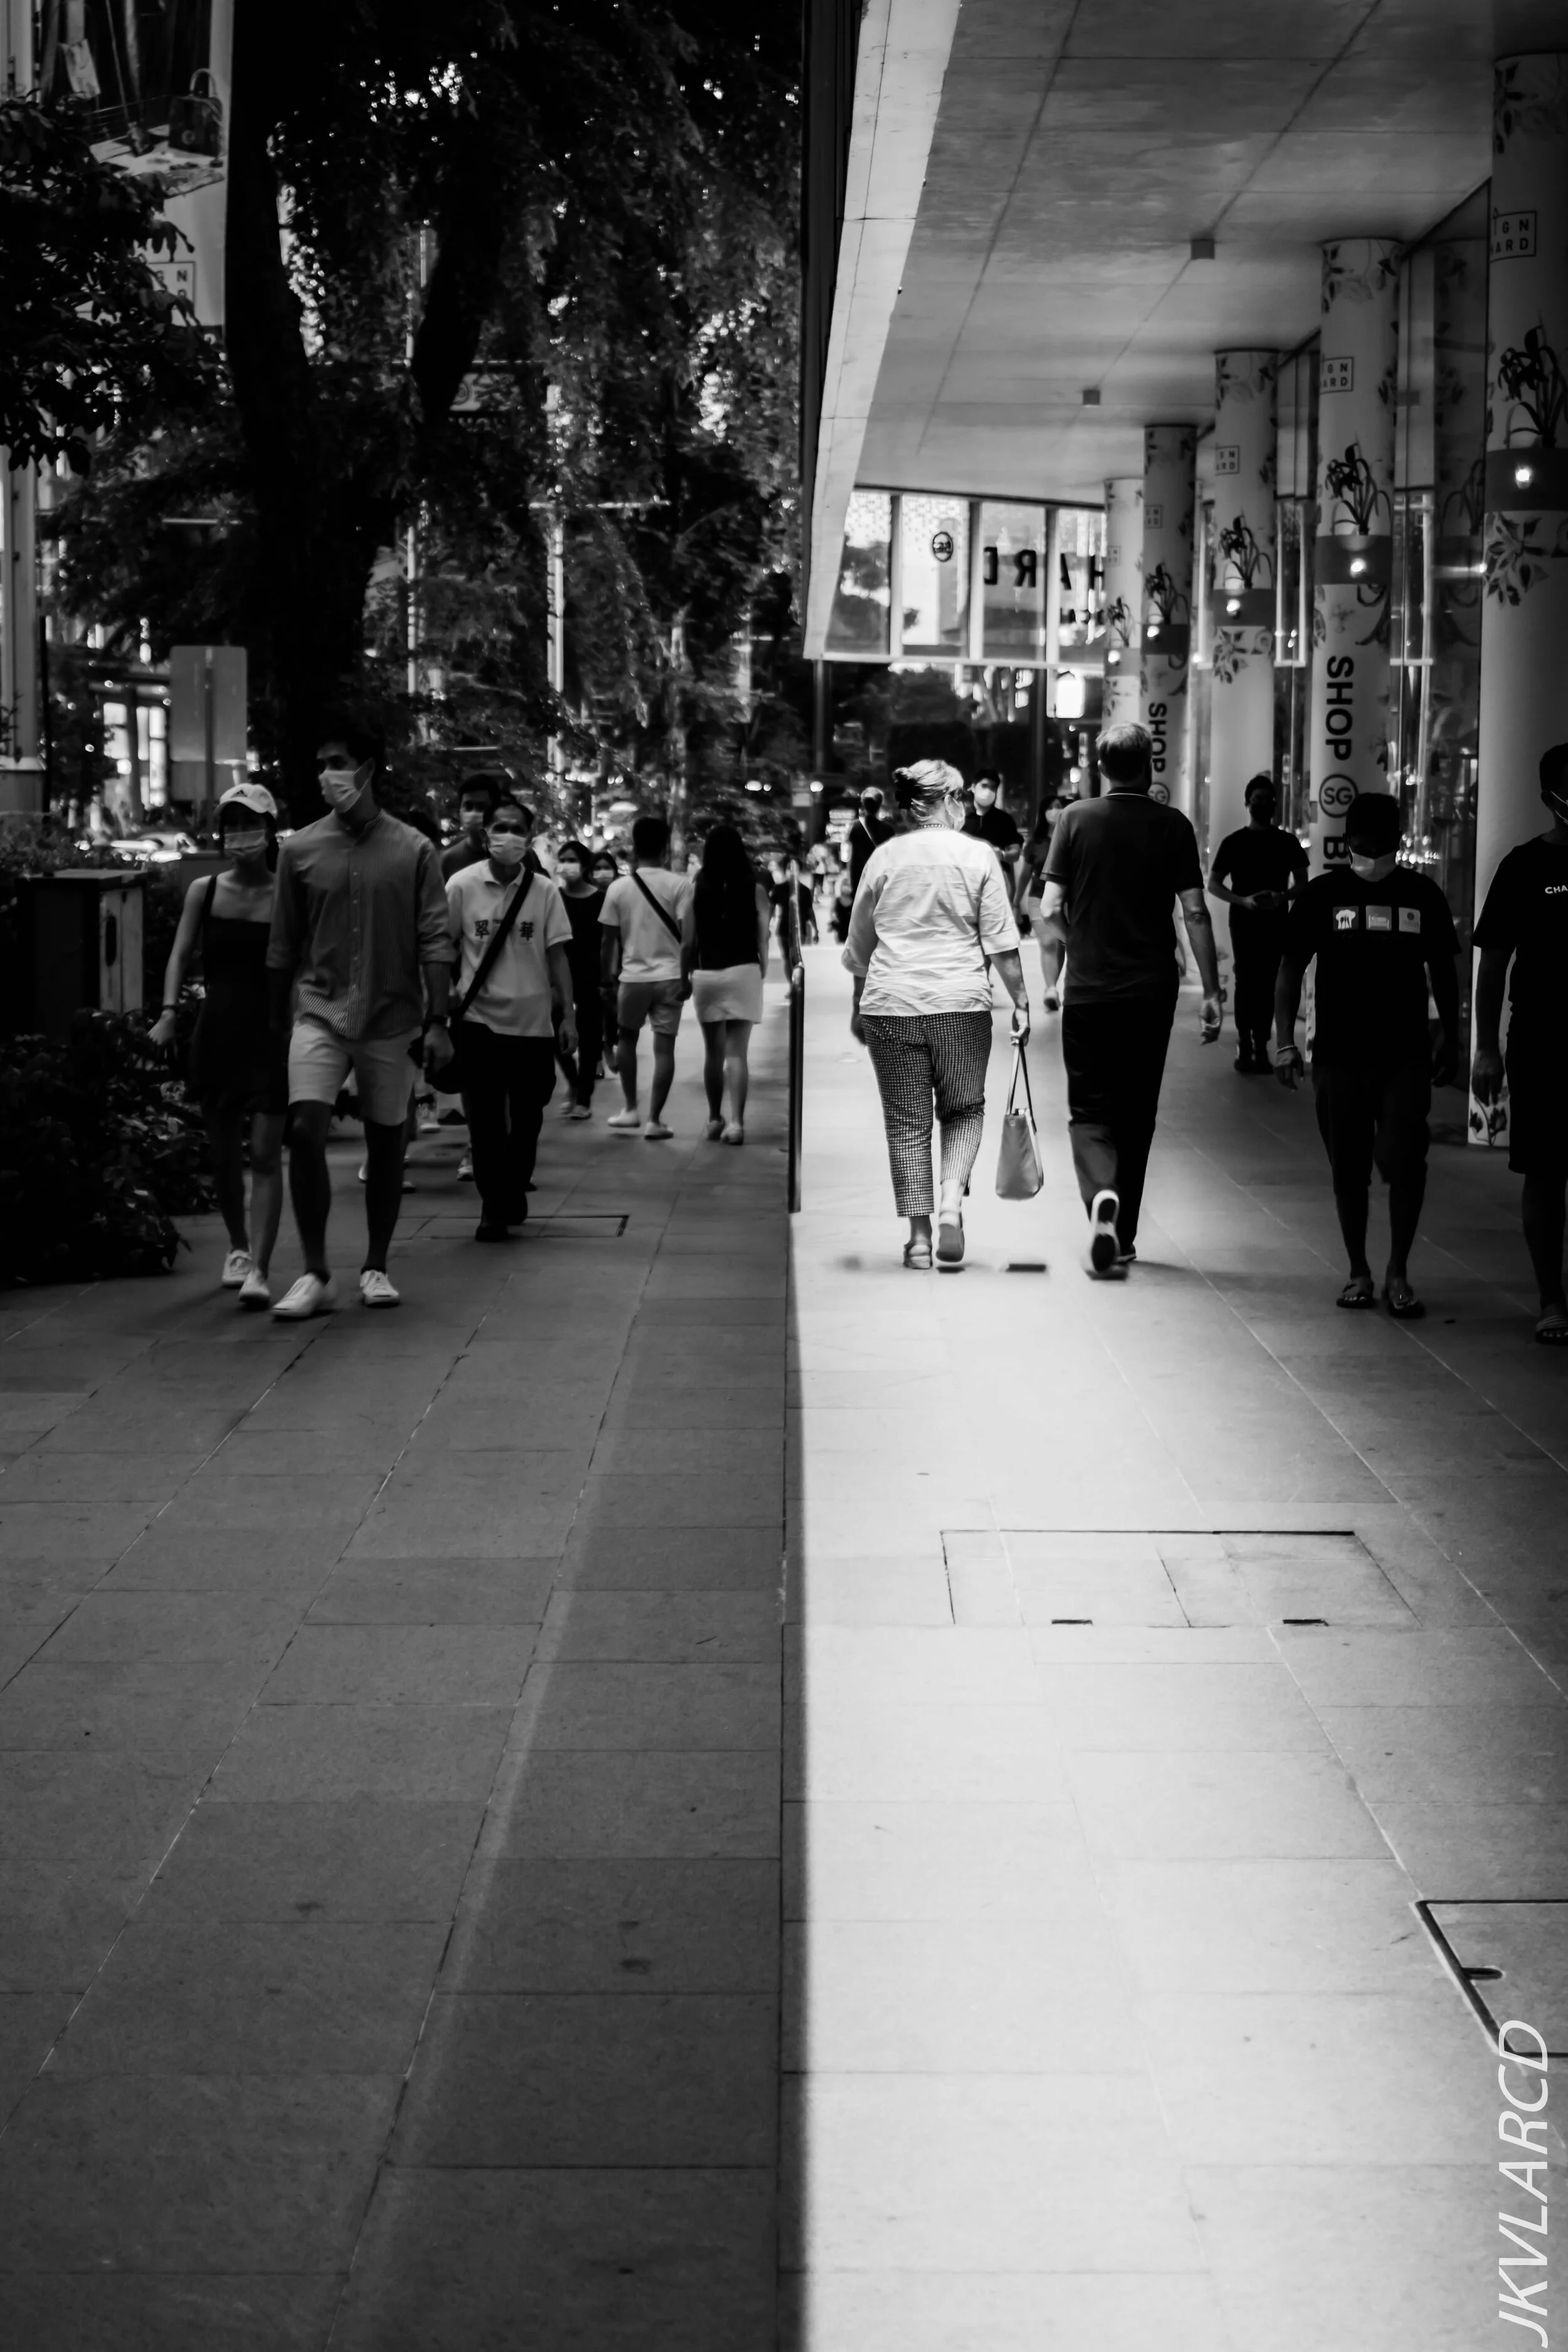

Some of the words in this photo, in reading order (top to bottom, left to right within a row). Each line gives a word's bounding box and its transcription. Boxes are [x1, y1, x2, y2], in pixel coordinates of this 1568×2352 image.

[1149, 702, 1167, 773] SHOP
[1326, 656, 1353, 761] SHOP
[1323, 787, 1353, 805] SG
